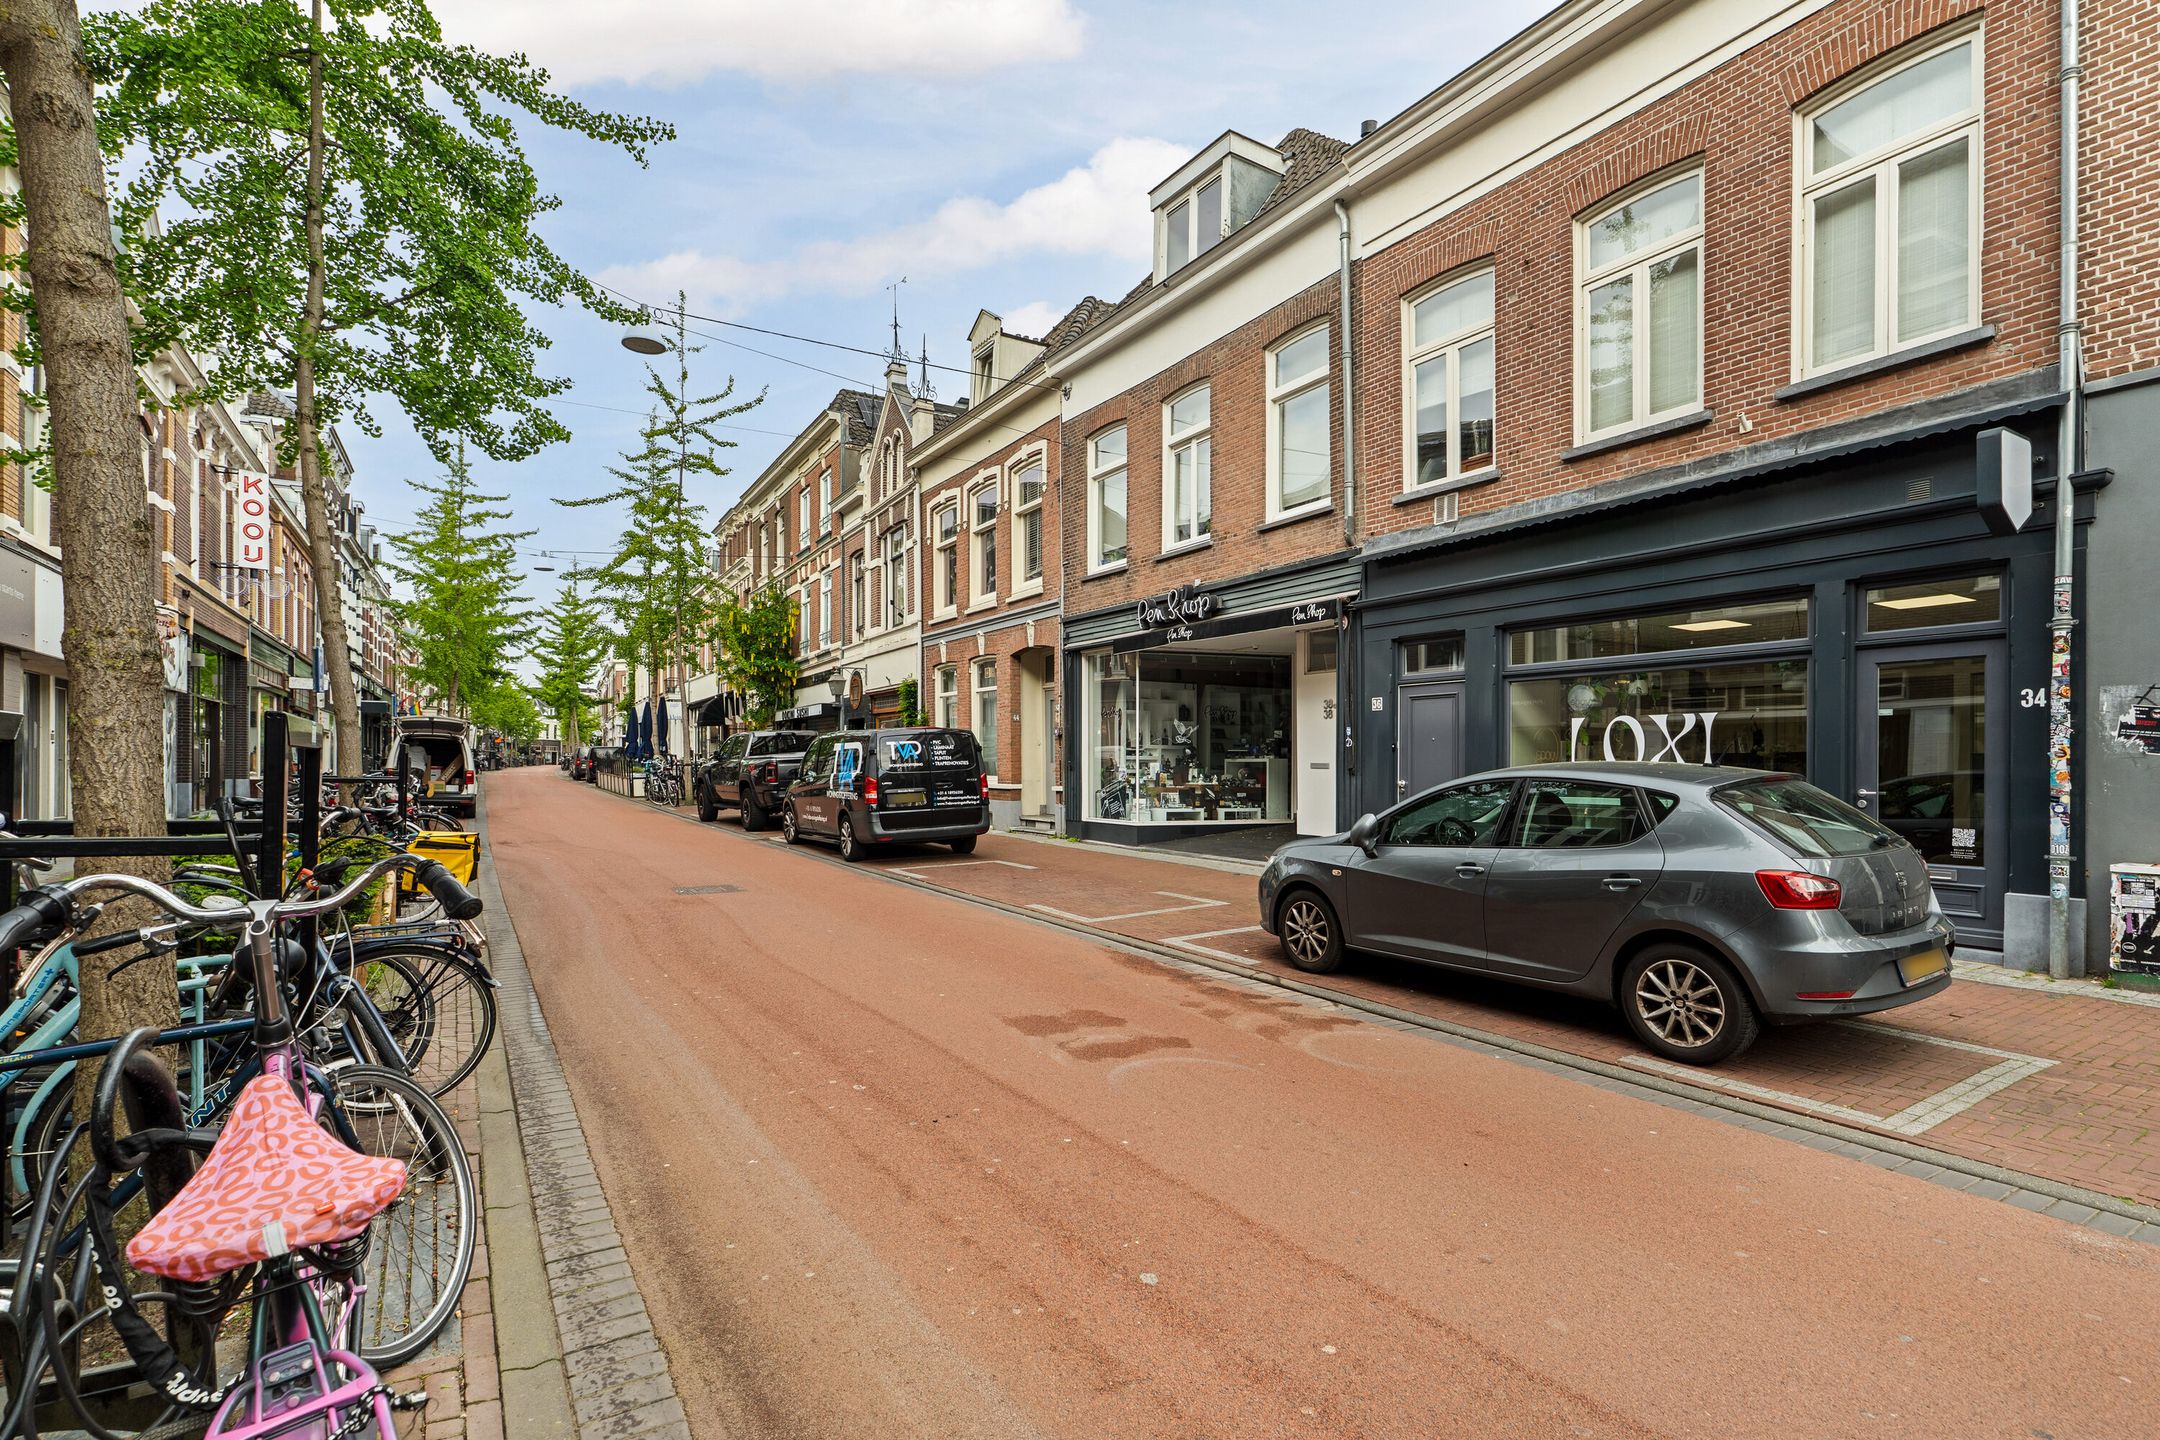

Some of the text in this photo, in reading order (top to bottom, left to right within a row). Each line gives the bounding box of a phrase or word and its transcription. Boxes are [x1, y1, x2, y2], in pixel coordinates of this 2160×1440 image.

[1136, 599, 1166, 629] Pen
[1292, 603, 1326, 625] Pen Shop
[1373, 700, 1382, 709] 36
[2020, 687, 2047, 708] 34
[1323, 710, 1333, 720] 38
